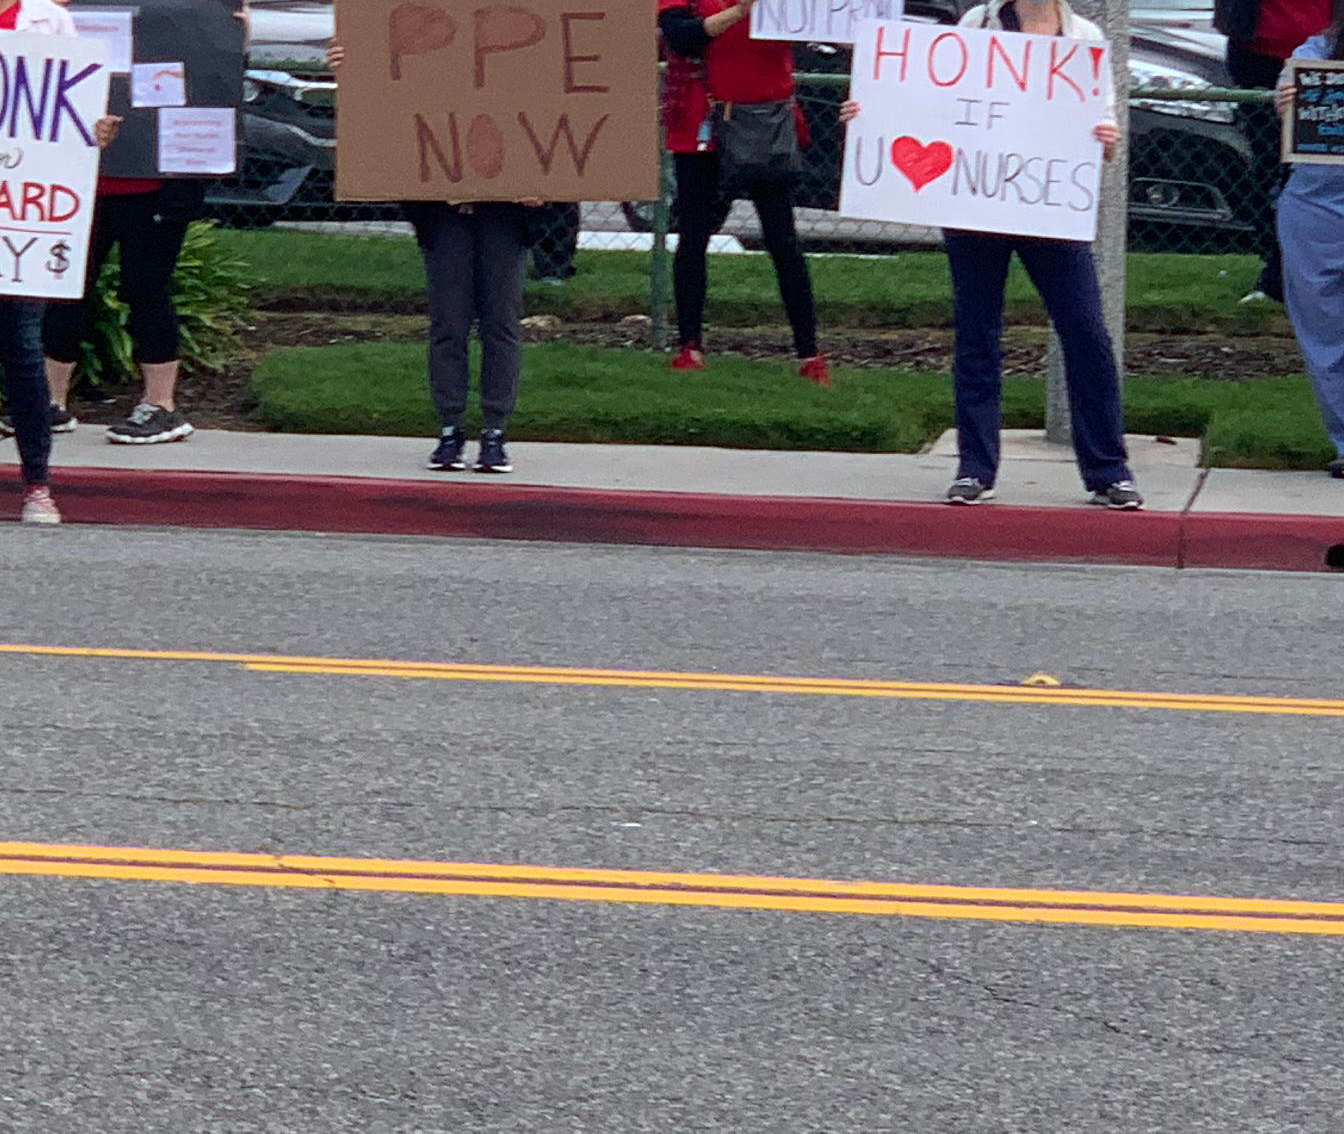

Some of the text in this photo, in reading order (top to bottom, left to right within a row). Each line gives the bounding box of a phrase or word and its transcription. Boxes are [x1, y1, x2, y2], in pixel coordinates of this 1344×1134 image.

[388, 3, 610, 95] PPE
[872, 26, 1105, 103] HONK!
[412, 112, 611, 183] NOW
[955, 98, 1010, 130] IF
[856, 136, 1096, 212] U NURSES
[46, 239, 72, 280] $
